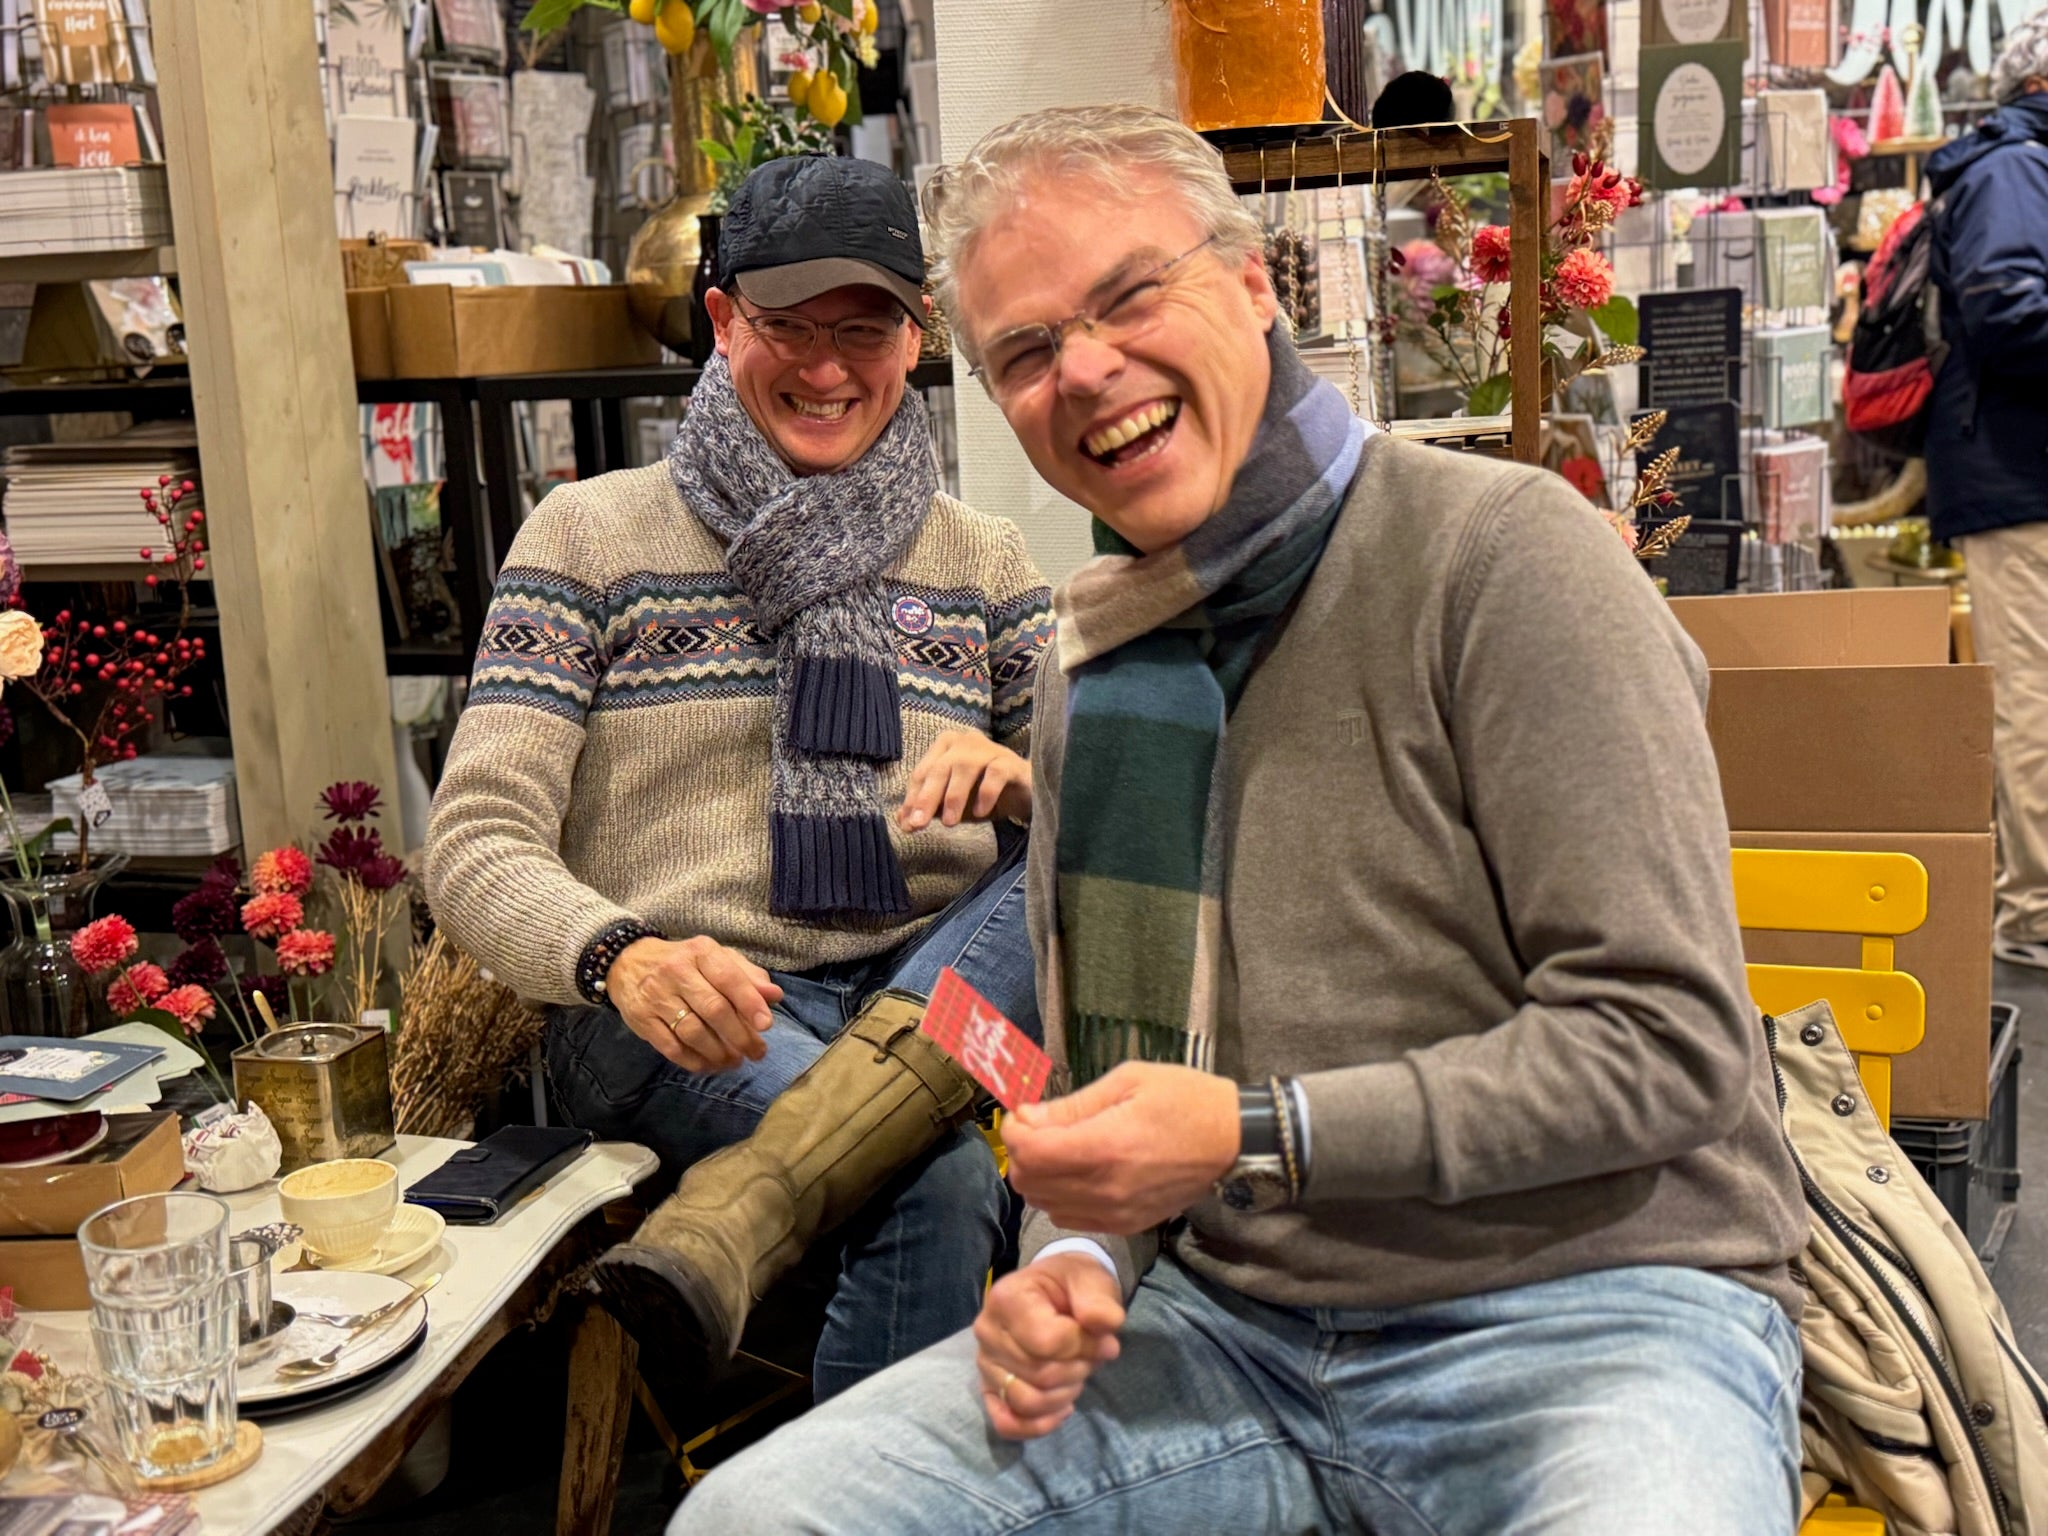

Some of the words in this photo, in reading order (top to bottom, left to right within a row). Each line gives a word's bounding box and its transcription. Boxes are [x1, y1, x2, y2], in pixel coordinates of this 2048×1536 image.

[266, 1068, 290, 1089] Sugar
[294, 1068, 318, 1090] Sugar
[269, 1087, 292, 1108] Sugar
[296, 1089, 320, 1110] Sugar
[298, 1109, 322, 1130] Sugar
[301, 1128, 325, 1150] Sugar
